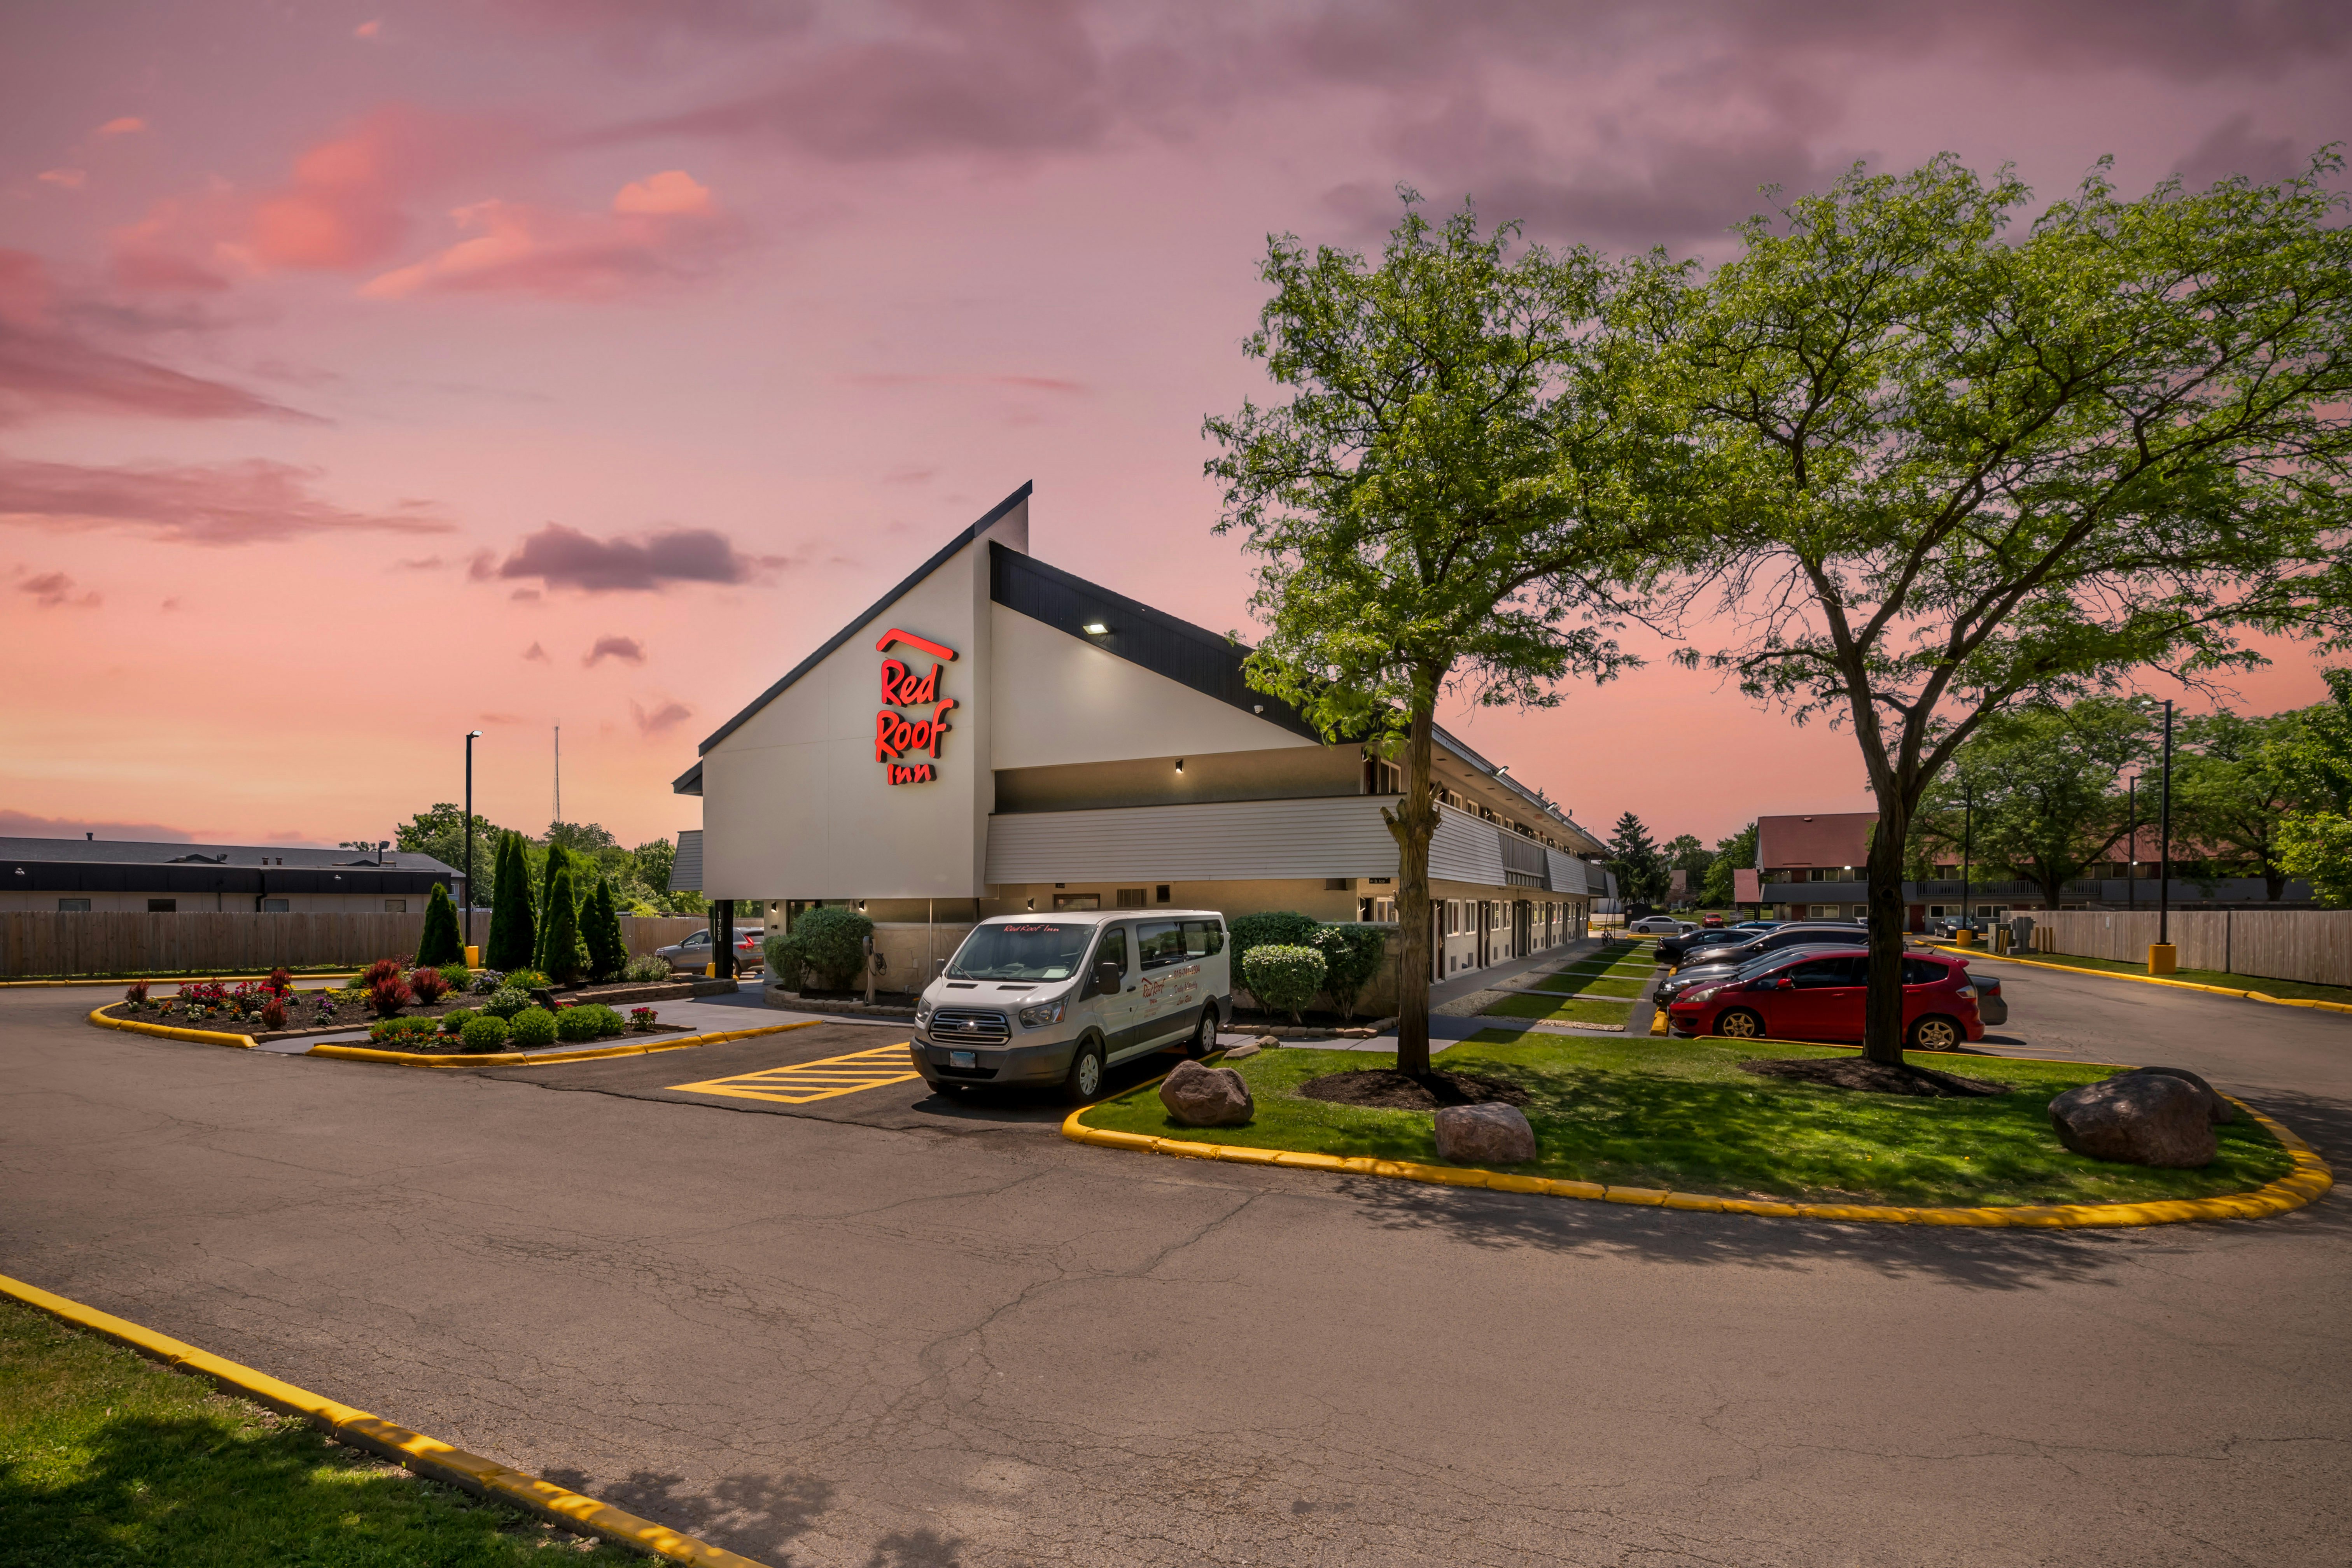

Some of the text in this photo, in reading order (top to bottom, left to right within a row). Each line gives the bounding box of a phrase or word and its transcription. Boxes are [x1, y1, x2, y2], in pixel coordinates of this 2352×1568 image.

[881, 659, 942, 707] Red
[875, 698, 957, 763] Roof
[887, 763, 935, 786] Inn
[1143, 978, 1166, 998] Red Roof
